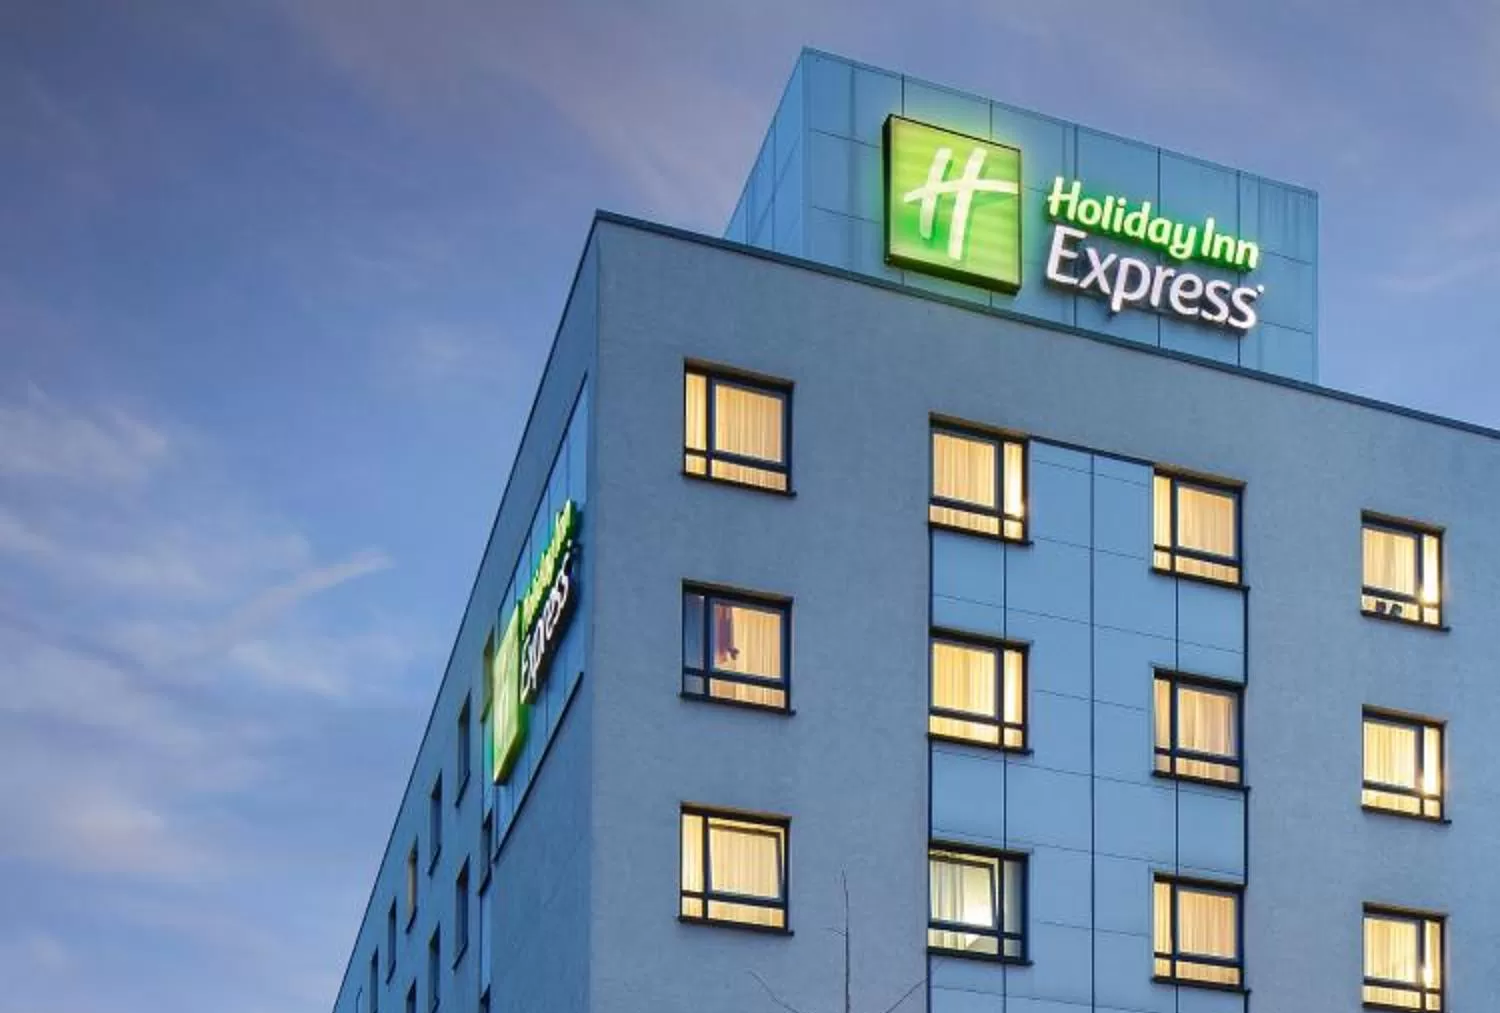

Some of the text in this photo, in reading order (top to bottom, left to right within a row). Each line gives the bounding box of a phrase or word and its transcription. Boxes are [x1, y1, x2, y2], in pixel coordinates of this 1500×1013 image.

[1047, 175, 1259, 269] Holiday Inn
[1046, 224, 1258, 330] Express
